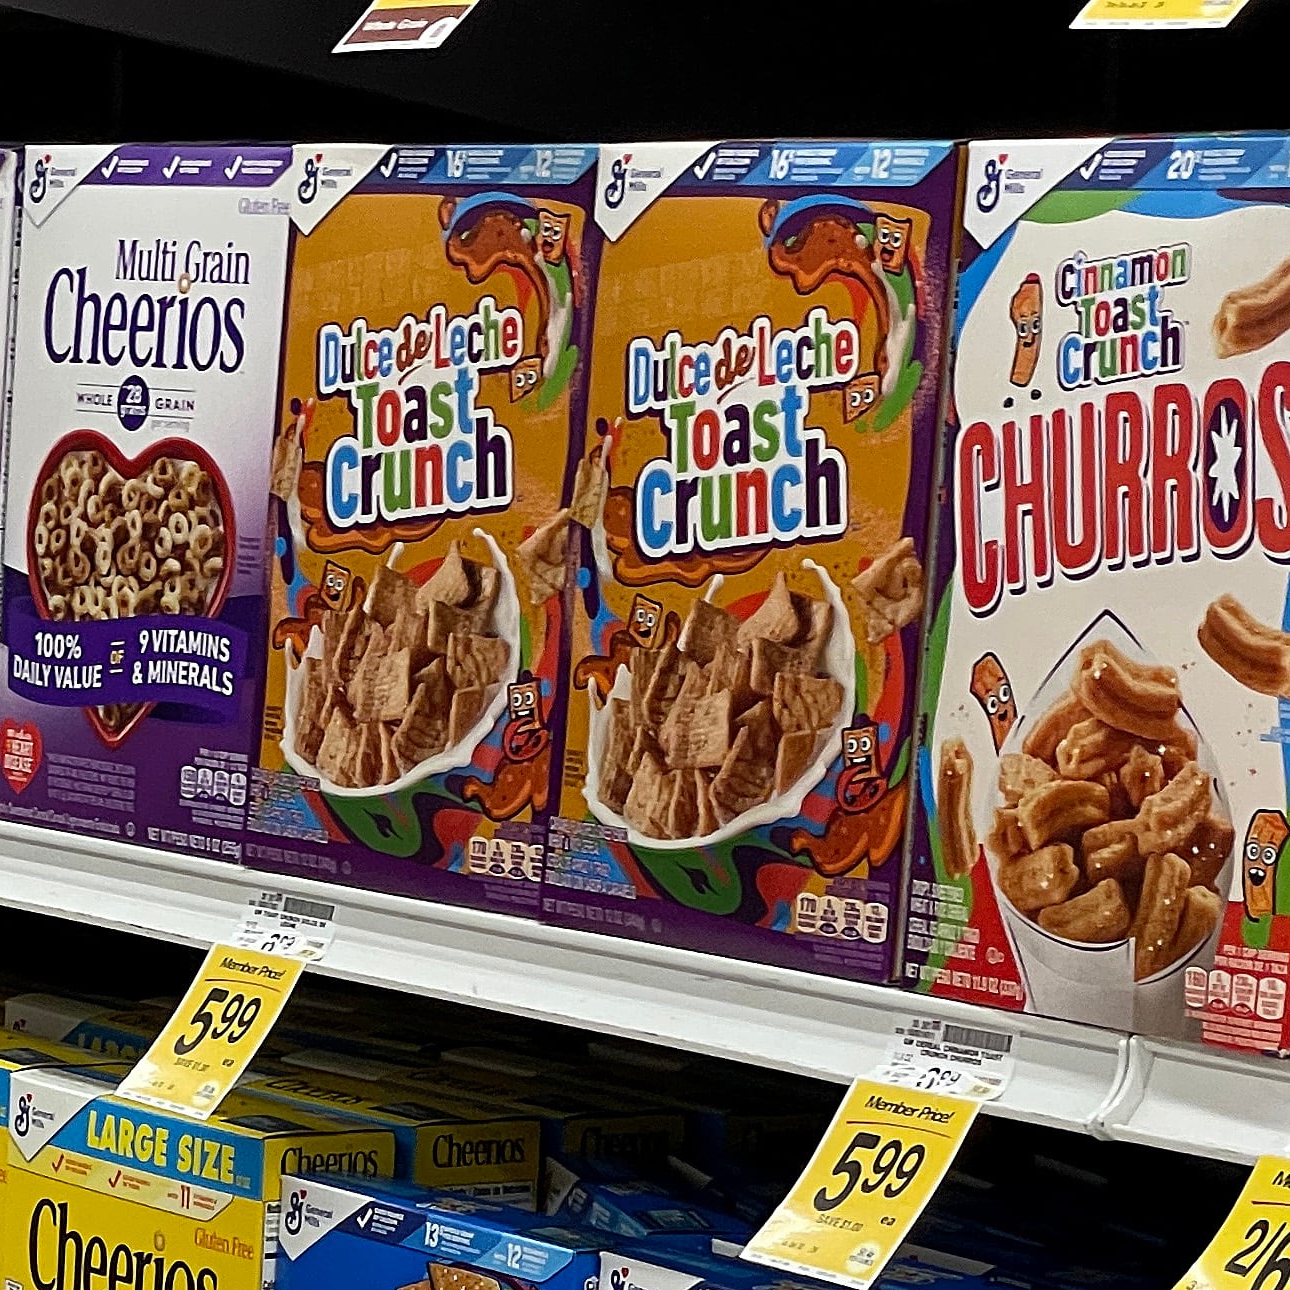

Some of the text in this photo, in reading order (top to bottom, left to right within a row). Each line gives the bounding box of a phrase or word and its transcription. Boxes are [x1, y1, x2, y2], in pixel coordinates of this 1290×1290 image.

[115, 239, 251, 285] Multi Grain
[1060, 247, 1188, 301] Cinnamon
[44, 268, 246, 375] Cheerios
[323, 299, 520, 390] Dulce de Leche
[1060, 315, 1184, 385] Crunch
[1081, 286, 1160, 335] Toast
[633, 310, 856, 406] Dulce de Leche
[355, 368, 476, 448] Toast
[669, 388, 803, 473] Toast
[329, 414, 509, 522] Crunch
[640, 436, 844, 543] Crunch
[961, 362, 1290, 610] CHURROS
[174, 986, 263, 1057] 599
[86, 1111, 236, 1184] LARGE SIZE
[864, 1094, 955, 1125] Member Price!
[813, 1131, 926, 1212] 599
